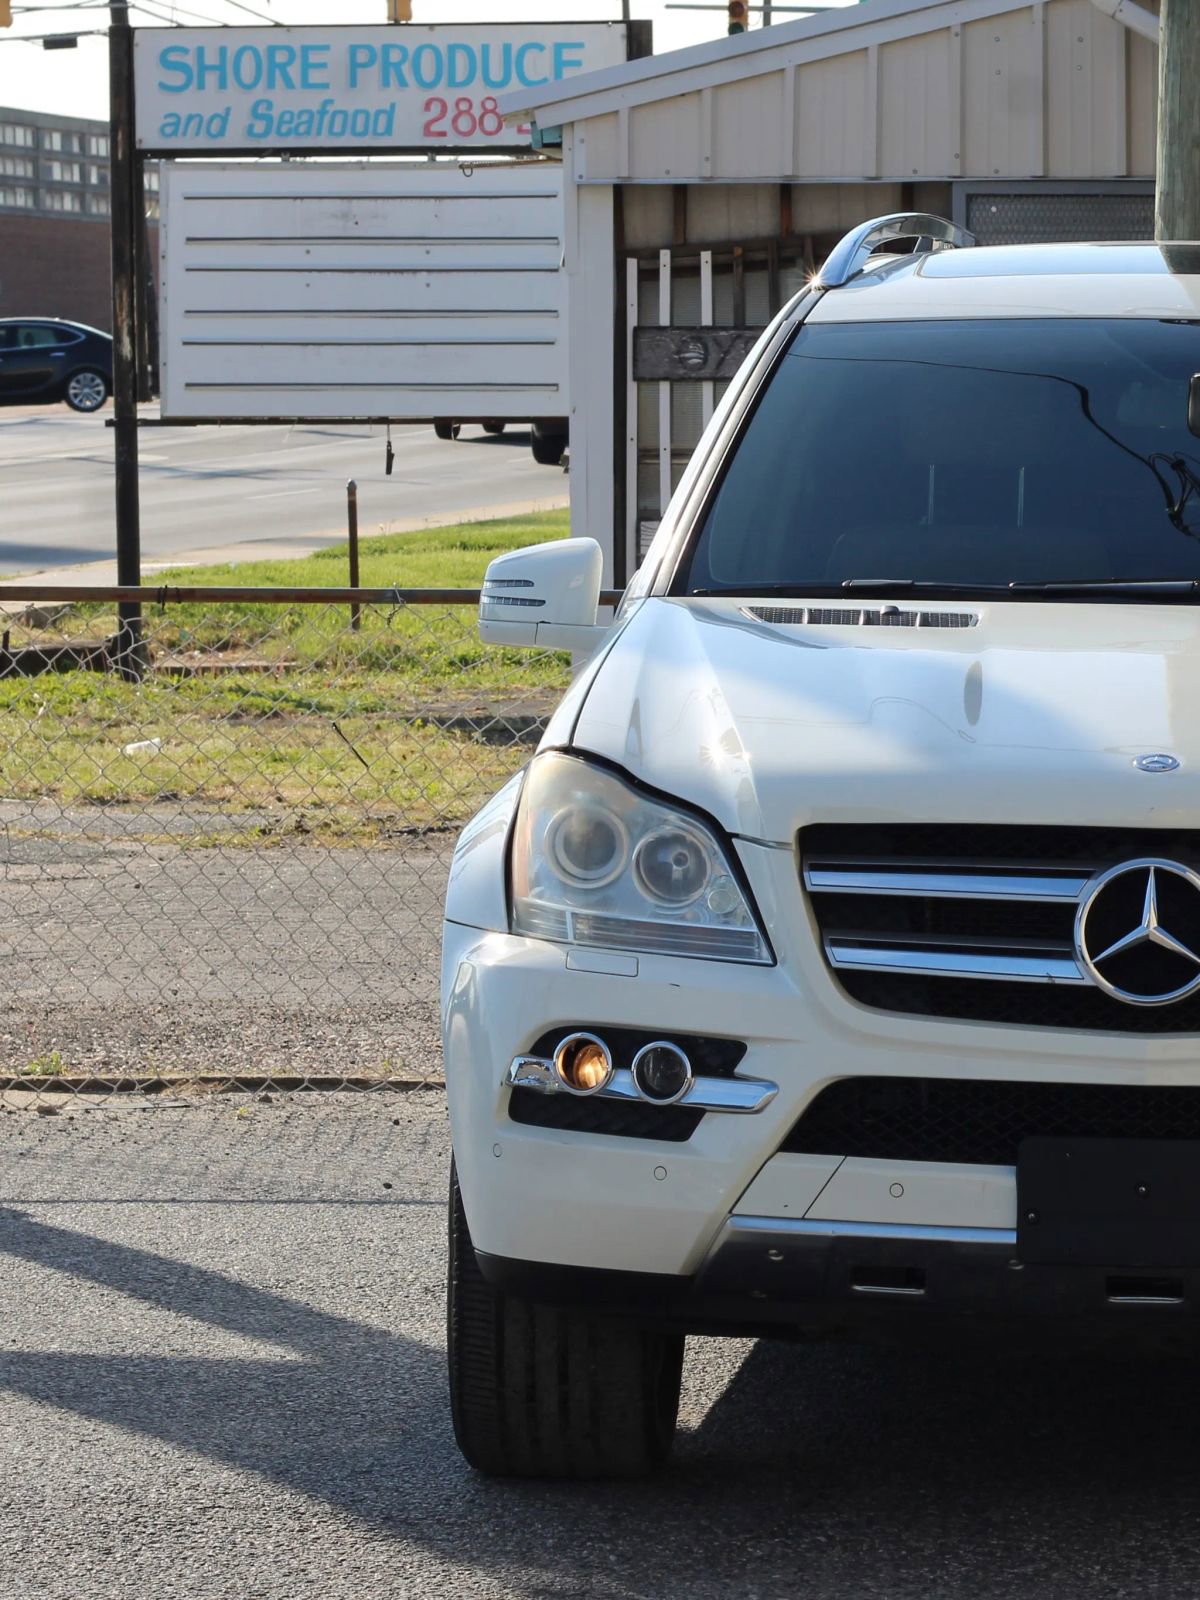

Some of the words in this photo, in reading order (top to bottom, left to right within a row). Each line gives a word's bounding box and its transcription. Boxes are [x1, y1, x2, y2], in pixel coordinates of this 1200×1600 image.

[158, 44, 331, 93] SHORE
[349, 41, 586, 90] PRODUCE
[159, 105, 232, 139] and
[246, 98, 397, 139] Seafood
